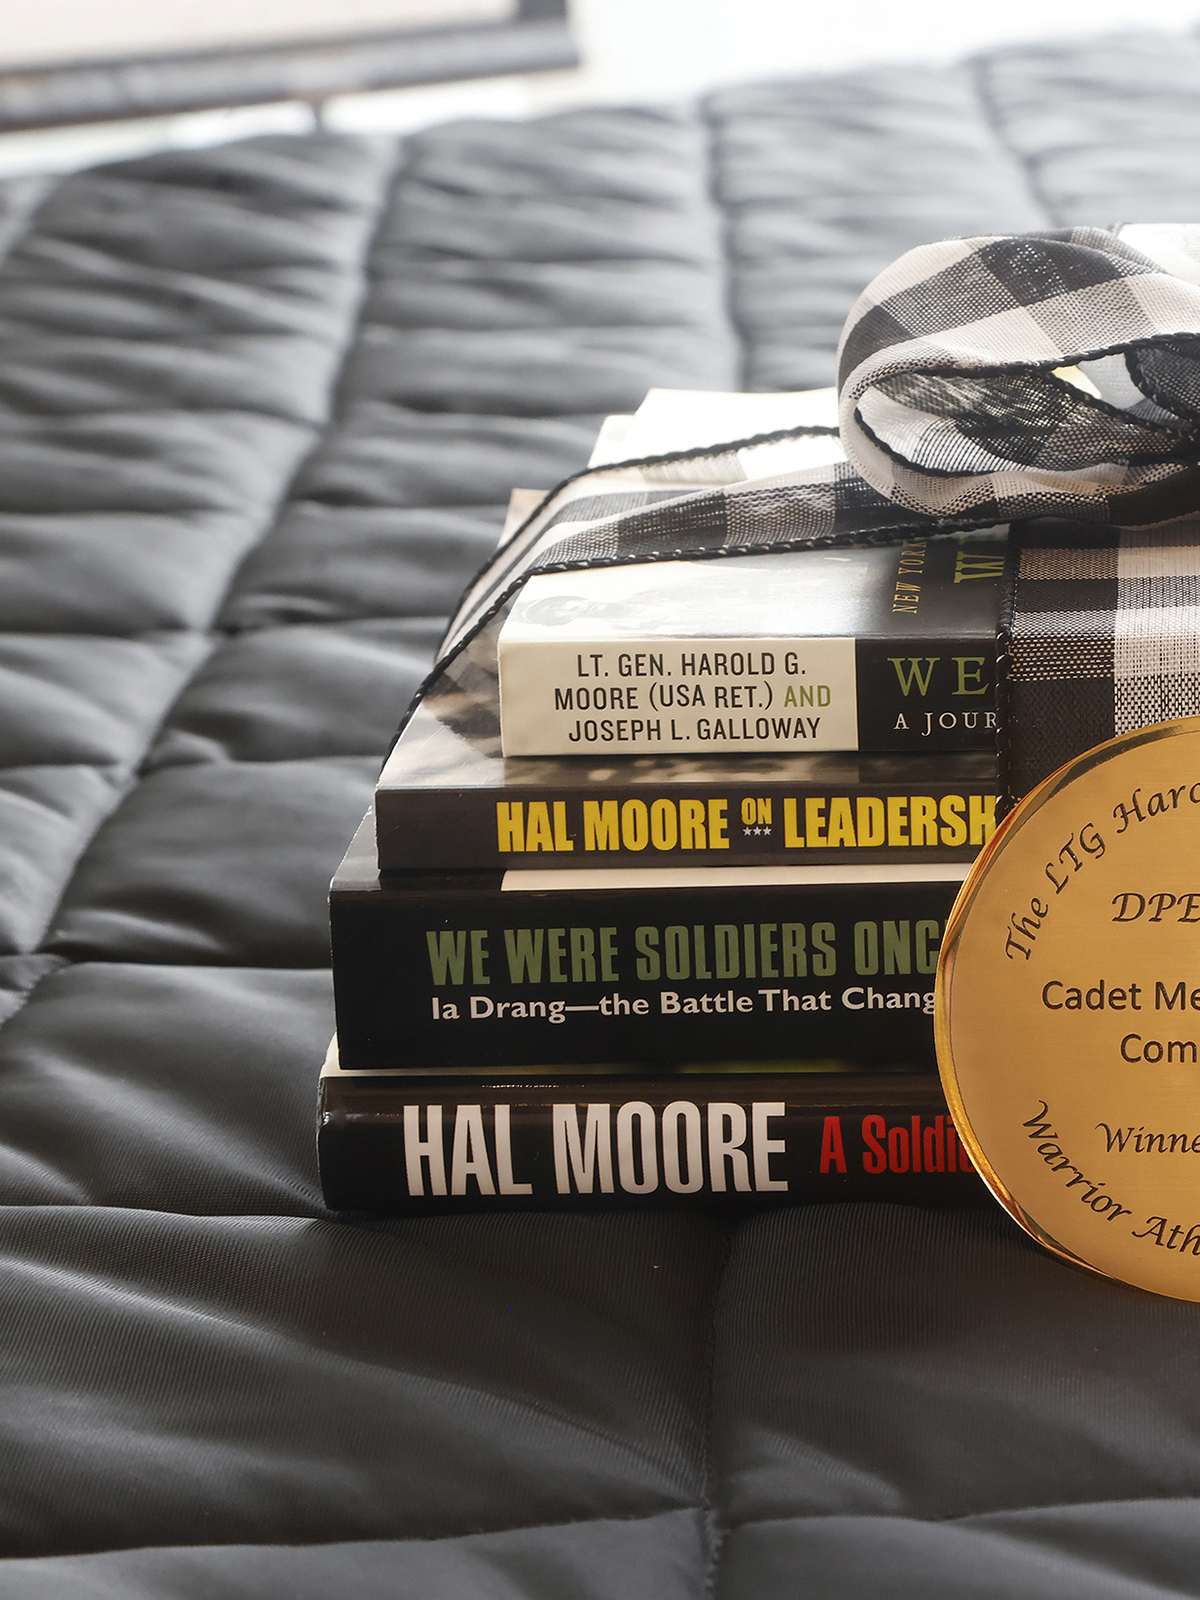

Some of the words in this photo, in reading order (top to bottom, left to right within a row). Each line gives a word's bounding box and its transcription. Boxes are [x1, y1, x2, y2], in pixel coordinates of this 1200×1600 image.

[898, 540, 927, 574] YORK
[892, 581, 922, 614] NEW
[577, 654, 609, 677] LT.
[618, 654, 672, 677] GEN.
[681, 652, 775, 677] HAROLD
[785, 651, 806, 676] G.
[887, 657, 989, 696] WE
[554, 686, 639, 711] MOORE
[649, 683, 706, 712] (USA
[714, 681, 774, 711] RET.)
[784, 684, 831, 708] AND
[568, 718, 661, 742] JOSEPH
[671, 718, 692, 741] L.
[697, 716, 821, 741] GALLOWAY
[893, 713, 910, 729] A
[921, 711, 997, 737] JOUR
[497, 801, 573, 852] HAL
[583, 798, 730, 852] MOORE
[741, 797, 772, 825] ON
[783, 795, 996, 848] LEADERSH
[1005, 897, 1048, 960] The
[1045, 823, 1106, 894] LTG
[426, 928, 490, 986] WE
[504, 926, 619, 984] WERE
[634, 922, 836, 982] SOLDIERS
[854, 919, 949, 976] ONC
[660, 990, 754, 1015] Battle
[758, 988, 832, 1013] That
[842, 986, 936, 1015] Chang
[1042, 981, 1141, 1012] Cadet
[403, 1103, 533, 1197] HAL
[552, 1100, 788, 1196] MOORE
[820, 1116, 847, 1174] A
[1023, 1100, 1132, 1221] Warrior
